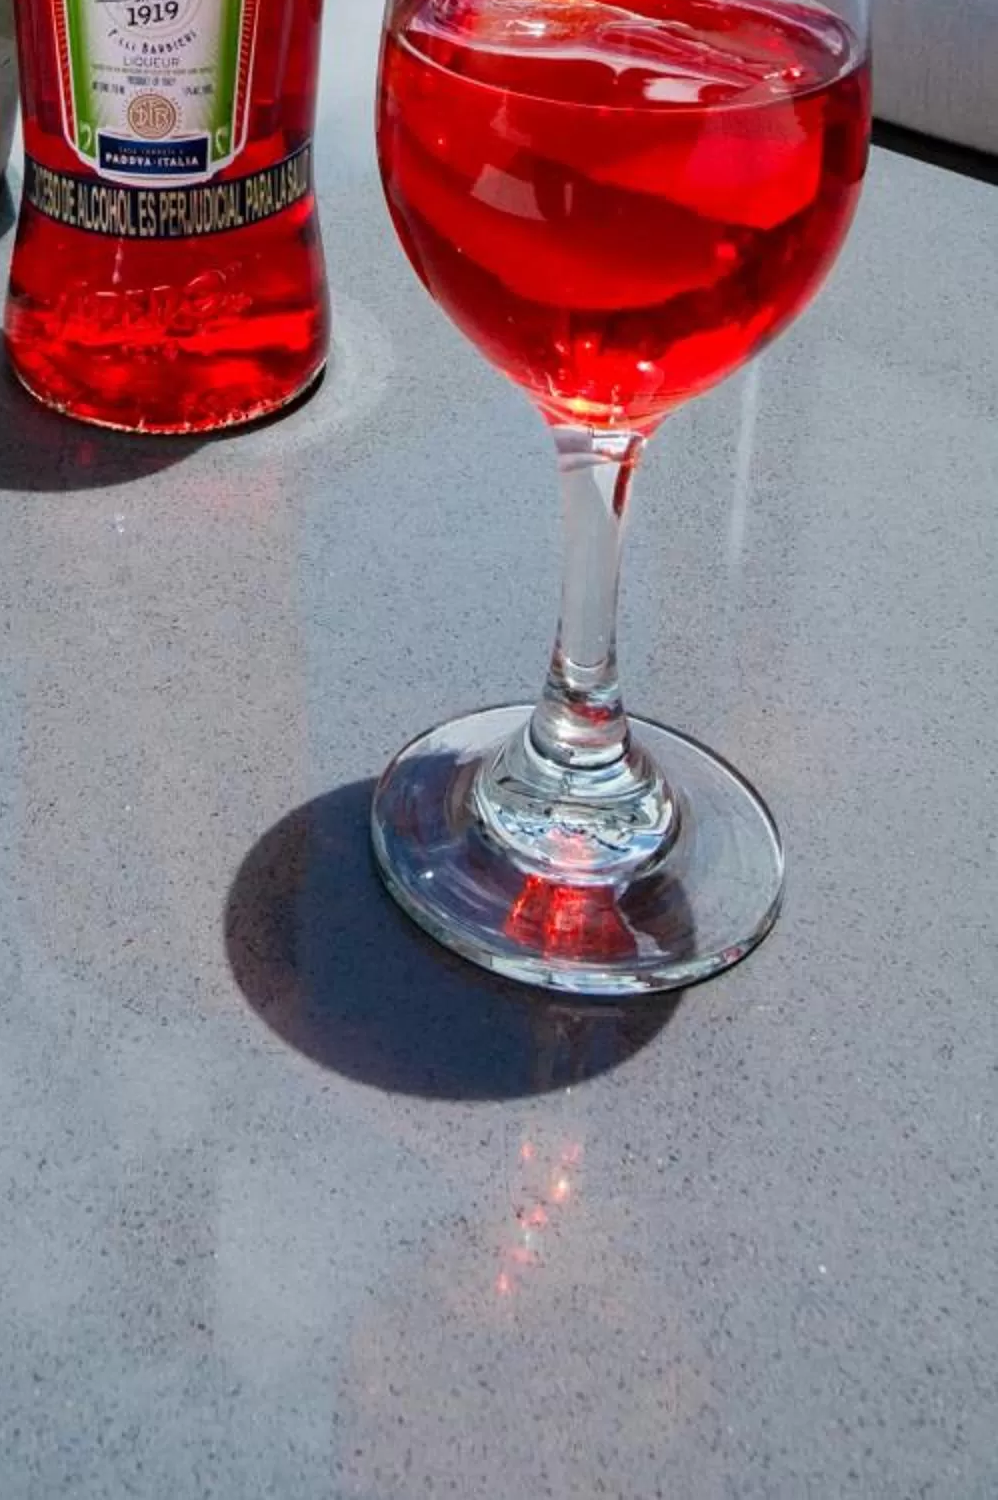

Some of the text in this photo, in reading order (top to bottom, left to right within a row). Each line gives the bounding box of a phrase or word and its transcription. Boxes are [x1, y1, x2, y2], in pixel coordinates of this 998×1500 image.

[127, 0, 179, 26] 1919
[123, 56, 180, 68] LIQUEUR
[78, 183, 136, 235] ALCOHOL
[138, 191, 157, 236] ES
[159, 181, 243, 237] PERJUDICIAL
[246, 170, 274, 223] PARA
